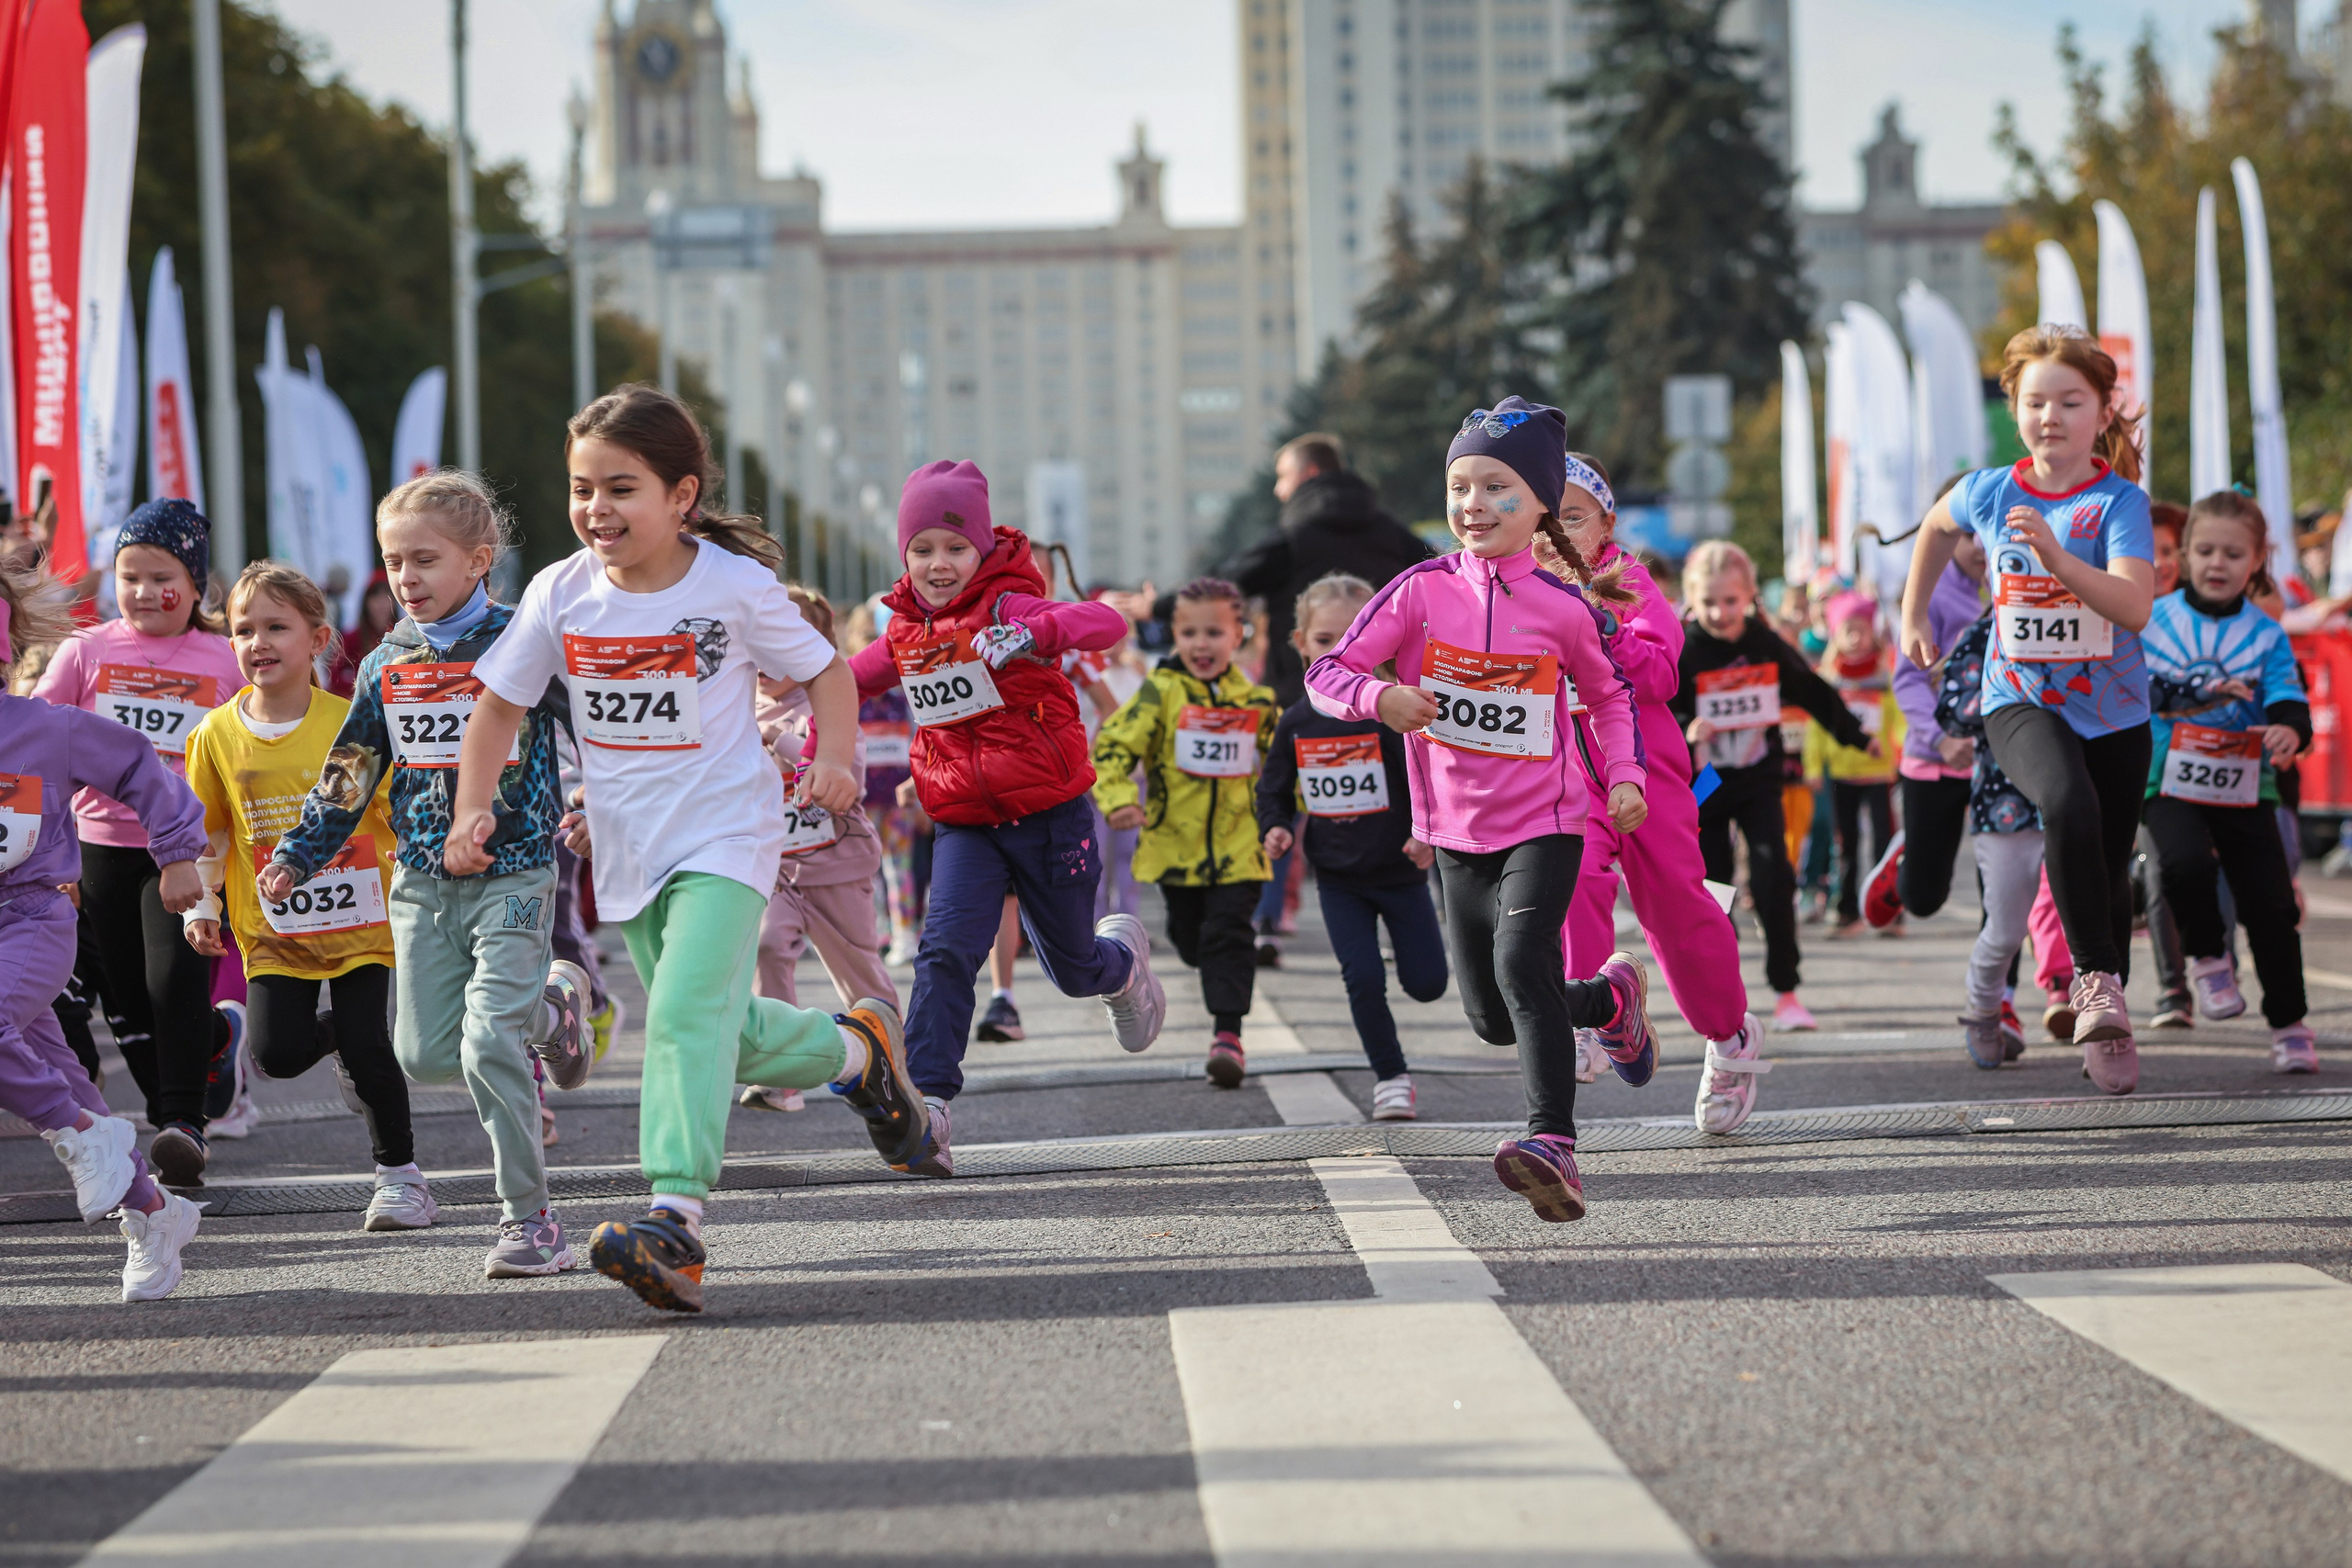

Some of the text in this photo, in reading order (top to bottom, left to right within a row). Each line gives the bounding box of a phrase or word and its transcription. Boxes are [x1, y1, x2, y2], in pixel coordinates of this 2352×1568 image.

[2073, 504, 2102, 521] 20
[2070, 521, 2100, 540] 25
[2014, 616, 2080, 642] 3141
[642, 670, 666, 680] 300
[451, 694, 473, 703] 300
[909, 676, 973, 709] 3020
[1495, 685, 1517, 694] 300
[584, 690, 680, 723] 3274
[1432, 691, 1527, 735] 3082
[113, 704, 185, 735] 3197
[398, 713, 471, 744] 322
[1191, 739, 1238, 761] 3211
[1307, 773, 1377, 797] 3094
[2177, 760, 2244, 790] 3267
[322, 866, 341, 876] 300
[503, 895, 542, 931] M
